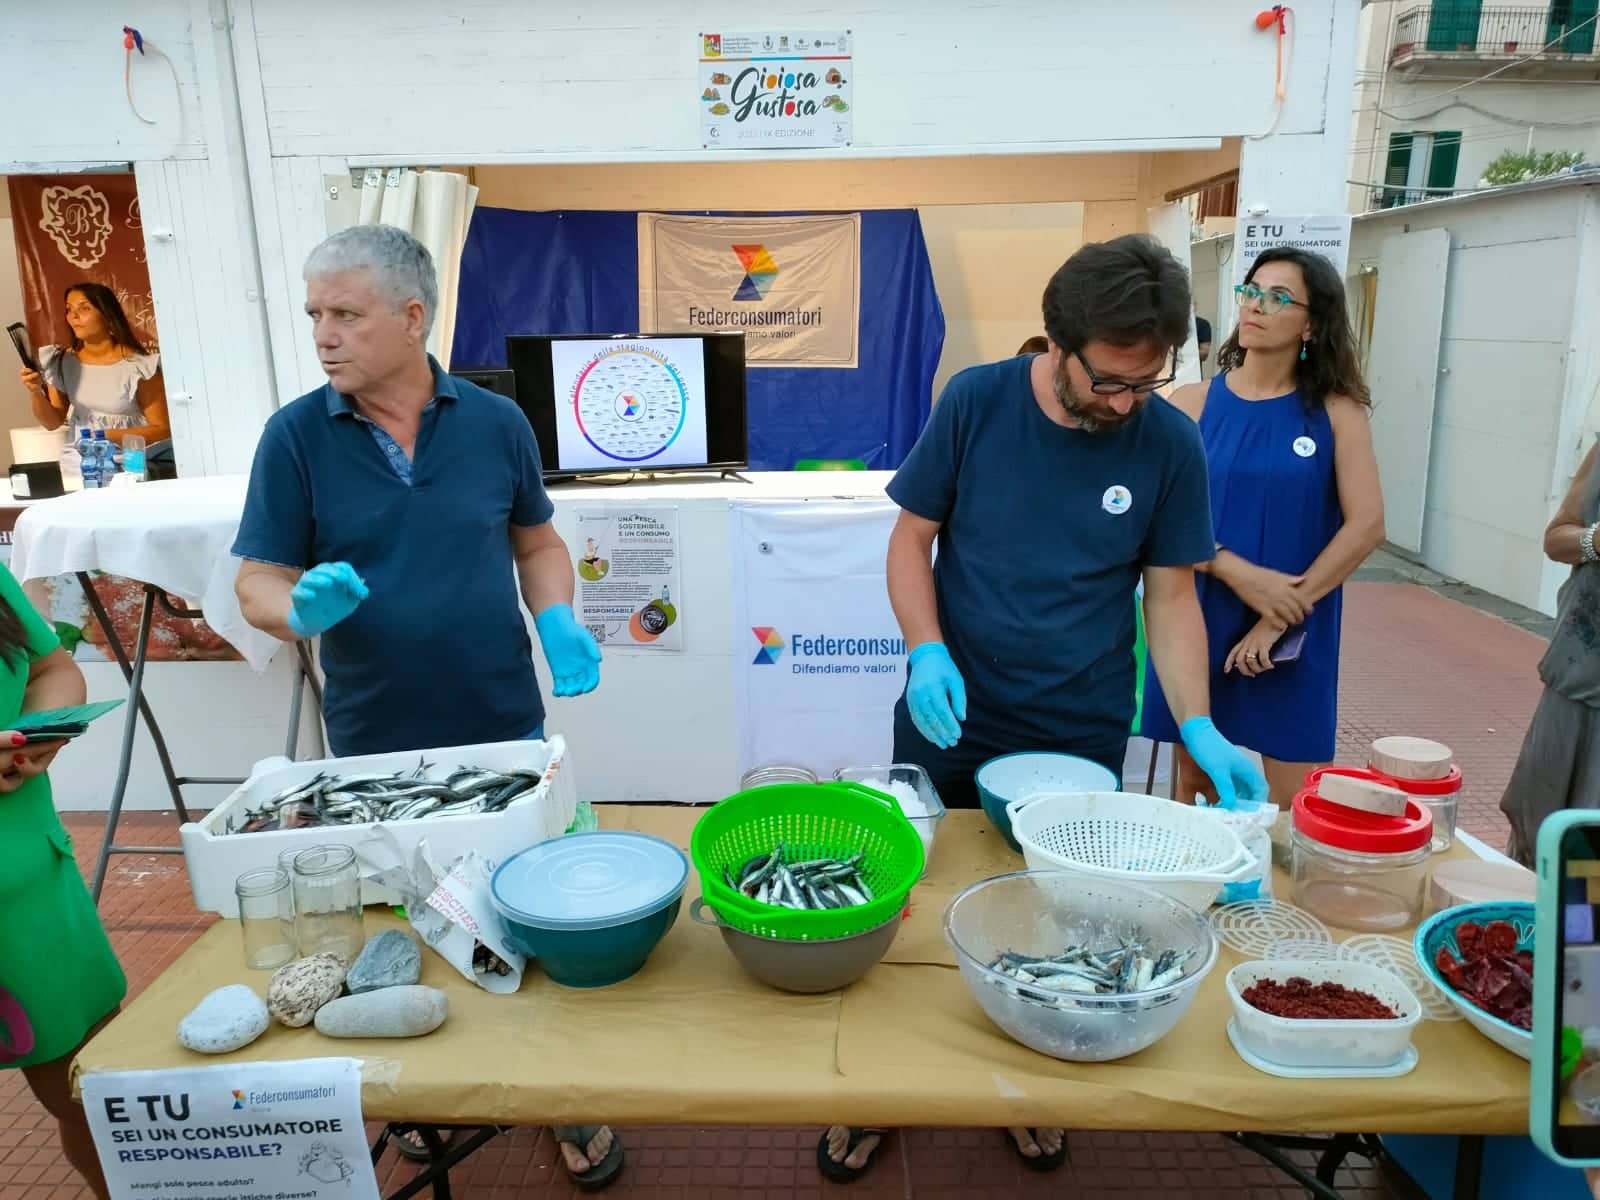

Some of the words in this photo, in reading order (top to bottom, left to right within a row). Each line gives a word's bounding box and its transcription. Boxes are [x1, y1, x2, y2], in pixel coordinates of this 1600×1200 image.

[731, 66, 821, 105] Gioiosa
[733, 87, 821, 122] Gustosa
[1246, 225, 1256, 237] E
[1262, 225, 1283, 238] TU
[1244, 240, 1258, 248] SEI
[1261, 240, 1273, 248] UN
[1275, 239, 1342, 248] CONSUMATORE
[689, 306, 822, 326] Federconsumatori
[792, 663, 860, 674] Difendiamo
[864, 663, 896, 674] valori
[249, 1084, 336, 1105] Federconsumatori
[104, 1097, 130, 1123] E
[137, 1093, 191, 1122] TU
[112, 1129, 143, 1143] SEI
[149, 1127, 177, 1142] UN
[183, 1119, 343, 1141] CONSUMATORE
[119, 1142, 283, 1163] RESPONSABILE?
[164, 1180, 184, 1188] solo
[186, 1180, 214, 1190] pesce
[217, 1177, 255, 1187] adulto?
[275, 1189, 318, 1199] diverse?
